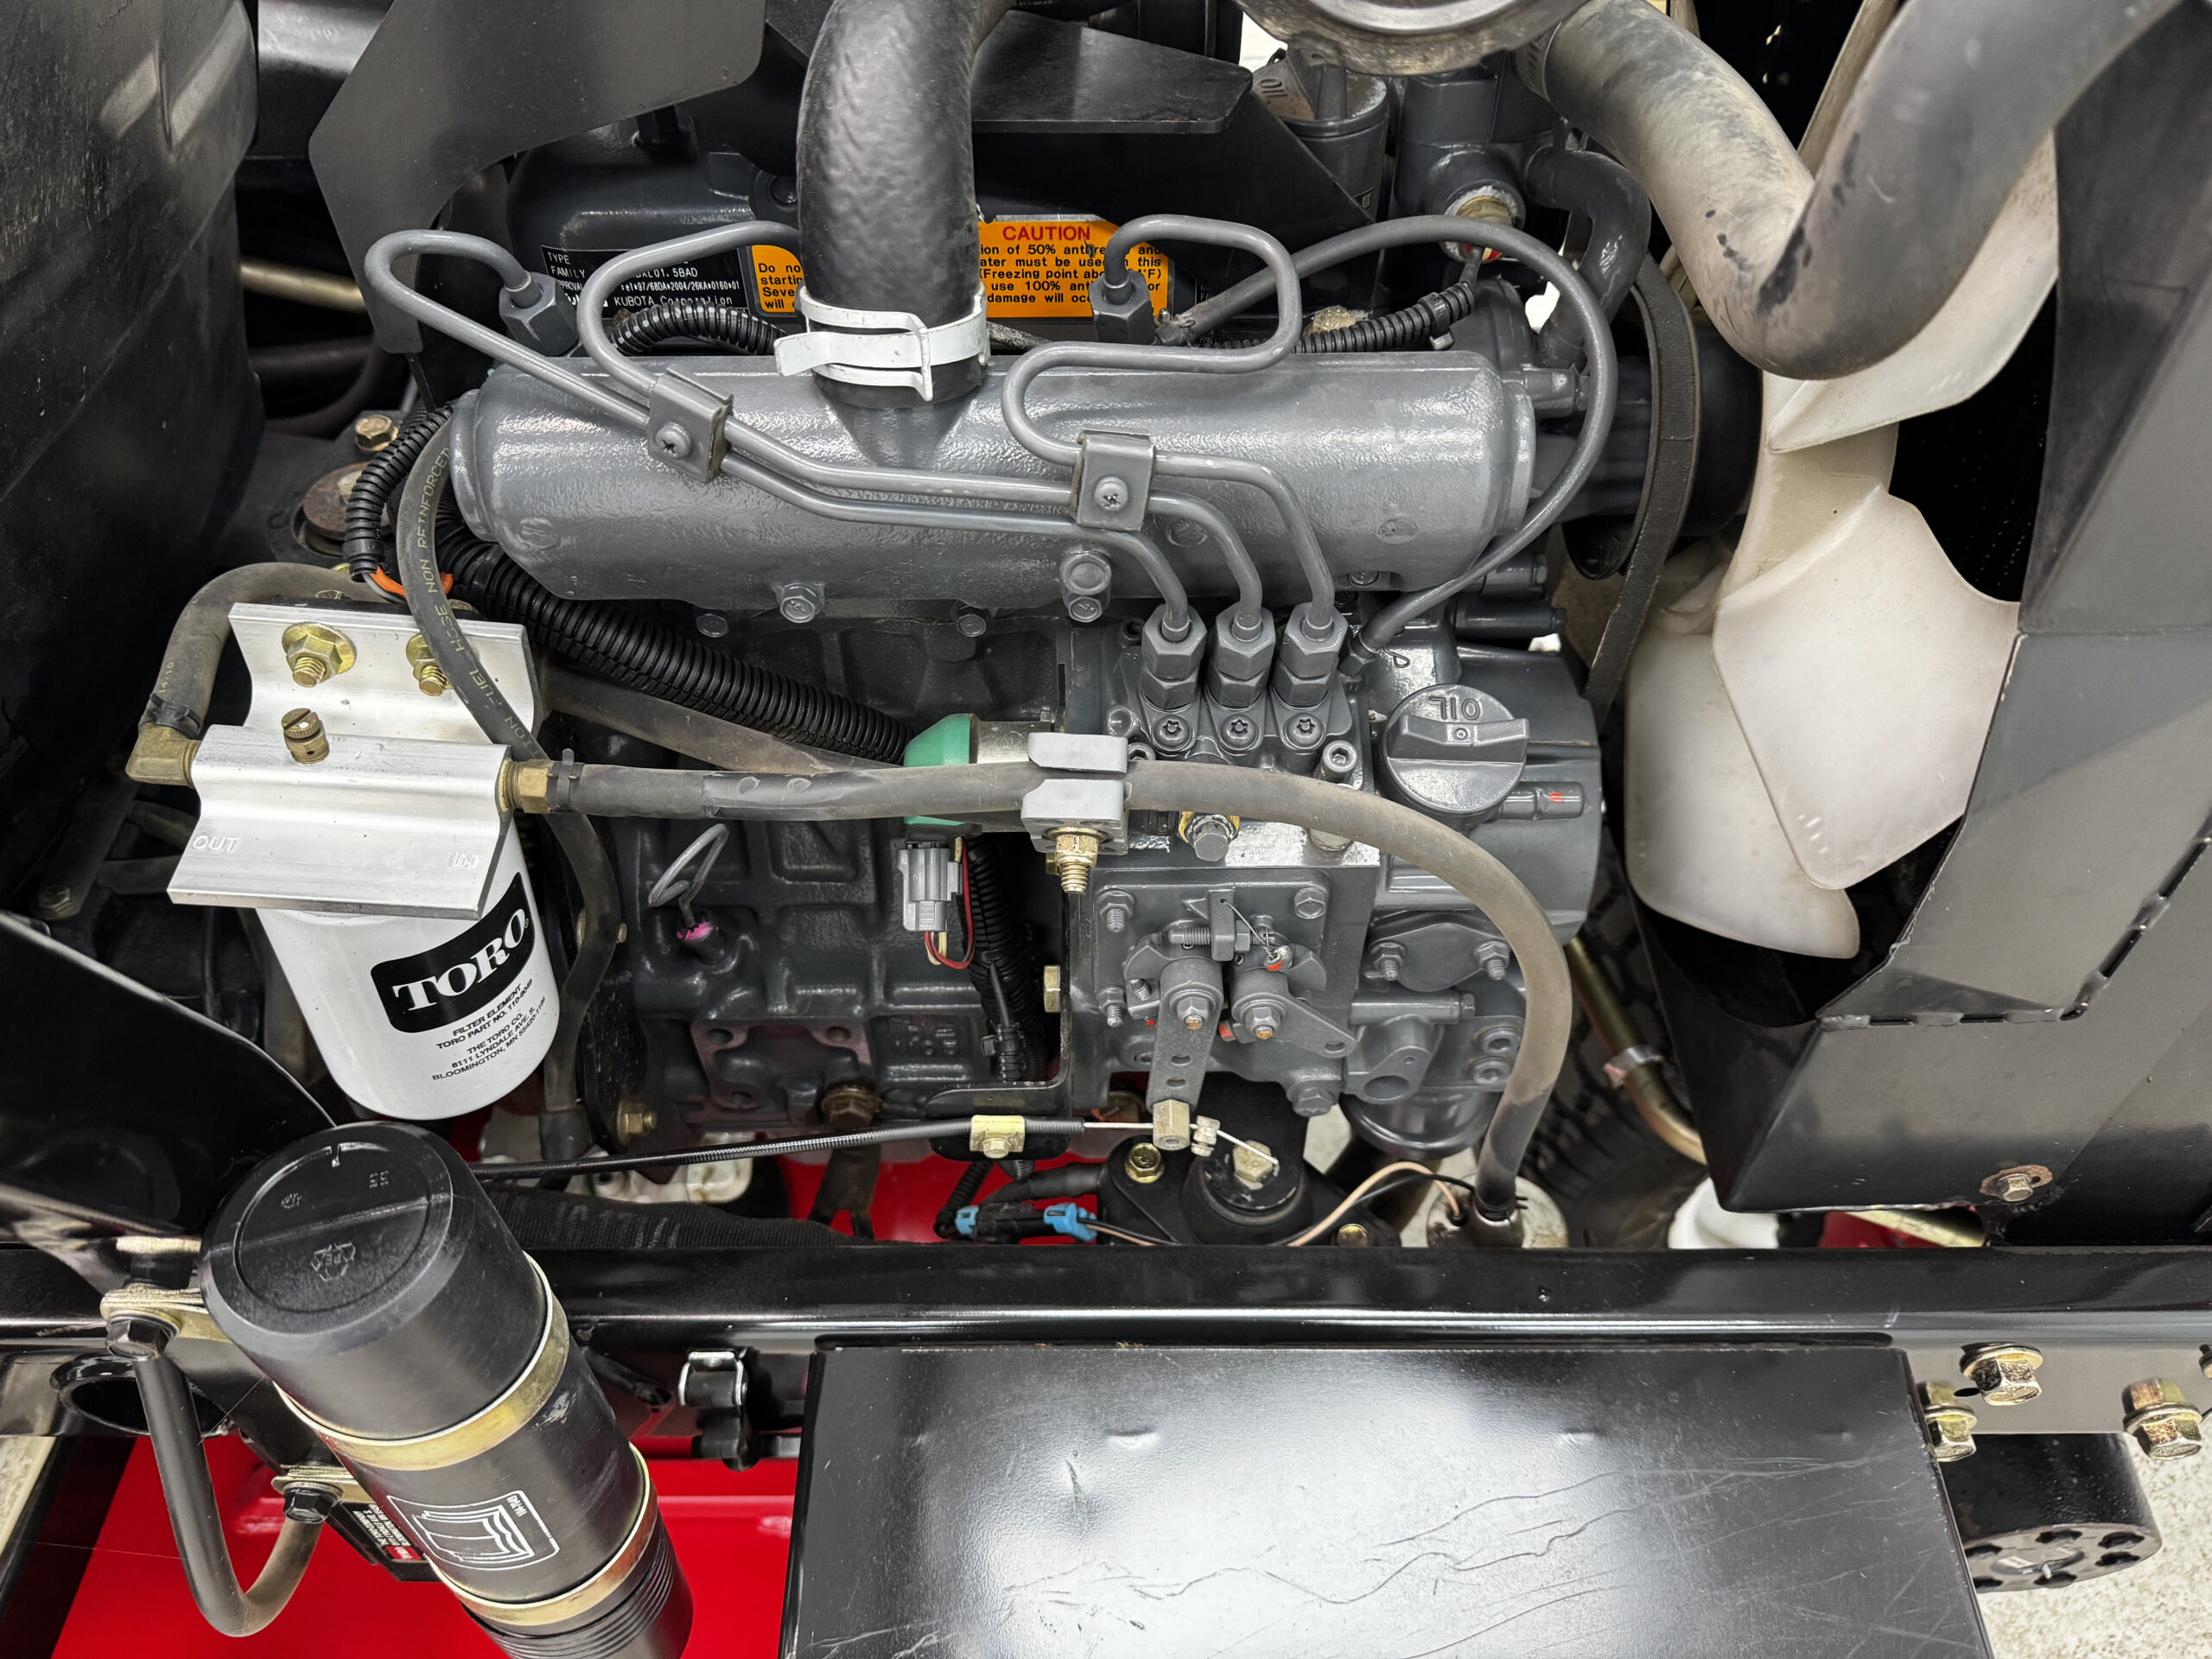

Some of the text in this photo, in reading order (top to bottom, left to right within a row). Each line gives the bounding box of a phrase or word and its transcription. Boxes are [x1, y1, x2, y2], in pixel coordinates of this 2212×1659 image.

[1002, 226, 1090, 241] CAUTION
[980, 244, 1000, 255] ion
[1007, 244, 1020, 255] of
[1027, 244, 1057, 255] 50%
[547, 251, 571, 264] TYPE
[980, 257, 1007, 267] ater
[1015, 257, 1048, 267] must
[1055, 257, 1071, 267] be
[1078, 257, 1104, 267] use
[1138, 257, 1162, 267] this
[550, 265, 586, 278] FAMILY
[758, 263, 802, 274] Do no
[979, 269, 1040, 279] (Freezing
[1046, 269, 1078, 279] point
[760, 275, 804, 285] startin
[991, 283, 1014, 291] use
[1025, 281, 1061, 291] 100%
[1147, 283, 1160, 291] or
[762, 286, 796, 297] Seve
[987, 293, 1036, 303] damage
[1044, 293, 1064, 302] will
[614, 296, 655, 306] KUBOTA
[764, 298, 785, 309] will
[420, 558, 440, 594] NON
[469, 669, 505, 710] FUEL
[193, 835, 241, 853] OUT
[392, 908, 526, 1012] TORO
[452, 983, 522, 1037] FILTER ELEMENT
[436, 1035, 466, 1050] TORO
[467, 1020, 492, 1039] PART
[467, 1040, 486, 1053] THE
[486, 1024, 511, 1043] TORO
[451, 1055, 474, 1068] 8111
[475, 1029, 514, 1058] LYNDALE
[432, 1046, 505, 1080] BLOOMINGTON,
[506, 1034, 518, 1048] MN
